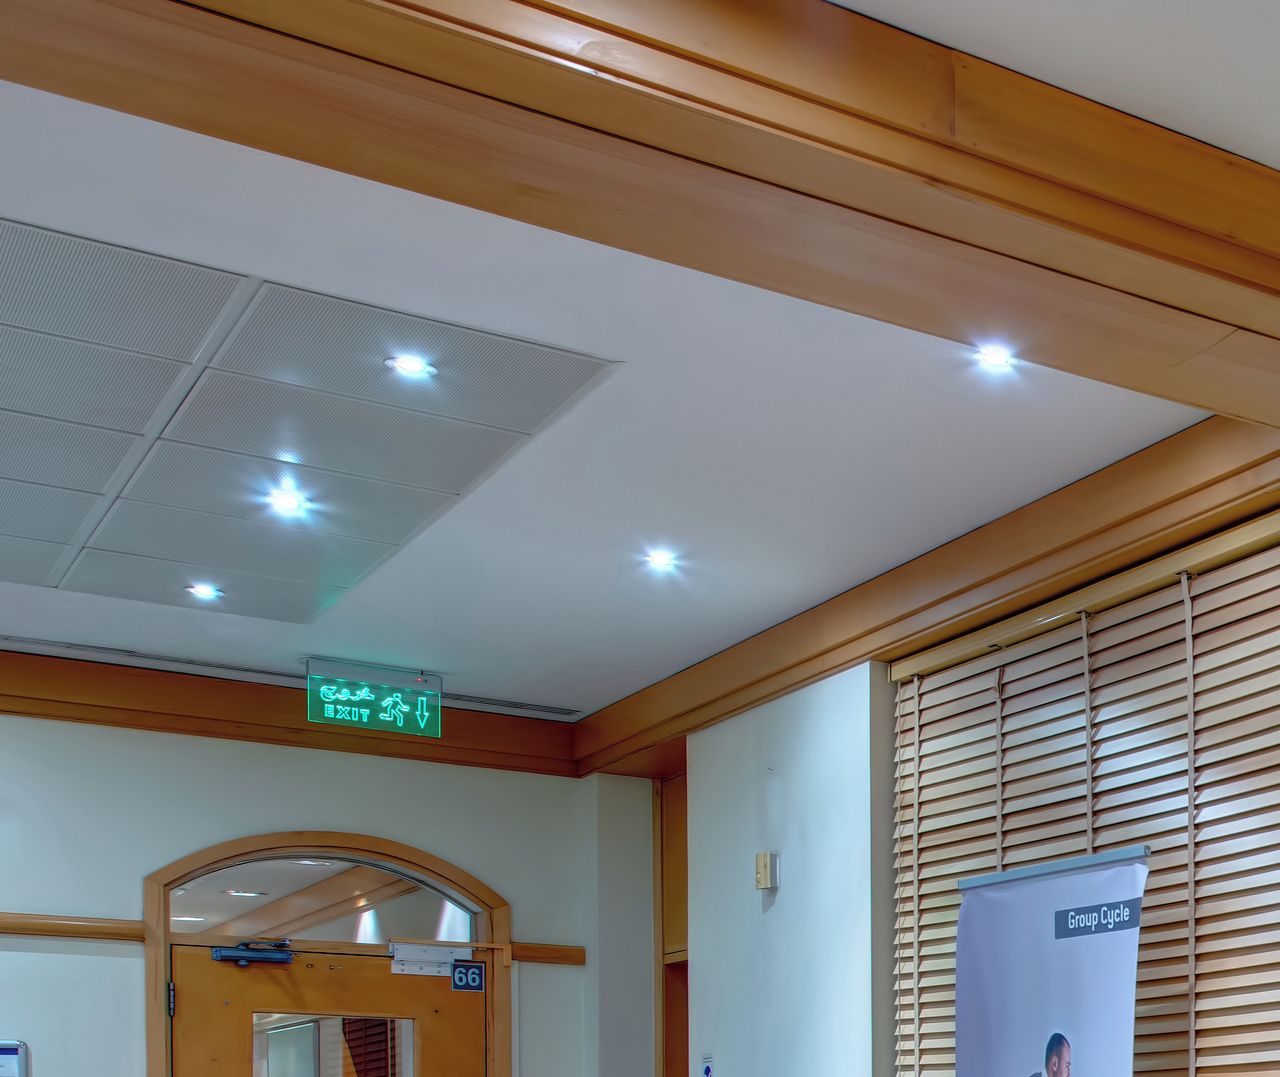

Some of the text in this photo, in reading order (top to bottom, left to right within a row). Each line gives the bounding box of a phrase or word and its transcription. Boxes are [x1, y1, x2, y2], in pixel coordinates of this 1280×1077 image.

[324, 703, 370, 723] EXIT
[1068, 904, 1130, 931] Group Cycle
[454, 967, 480, 987] 66
